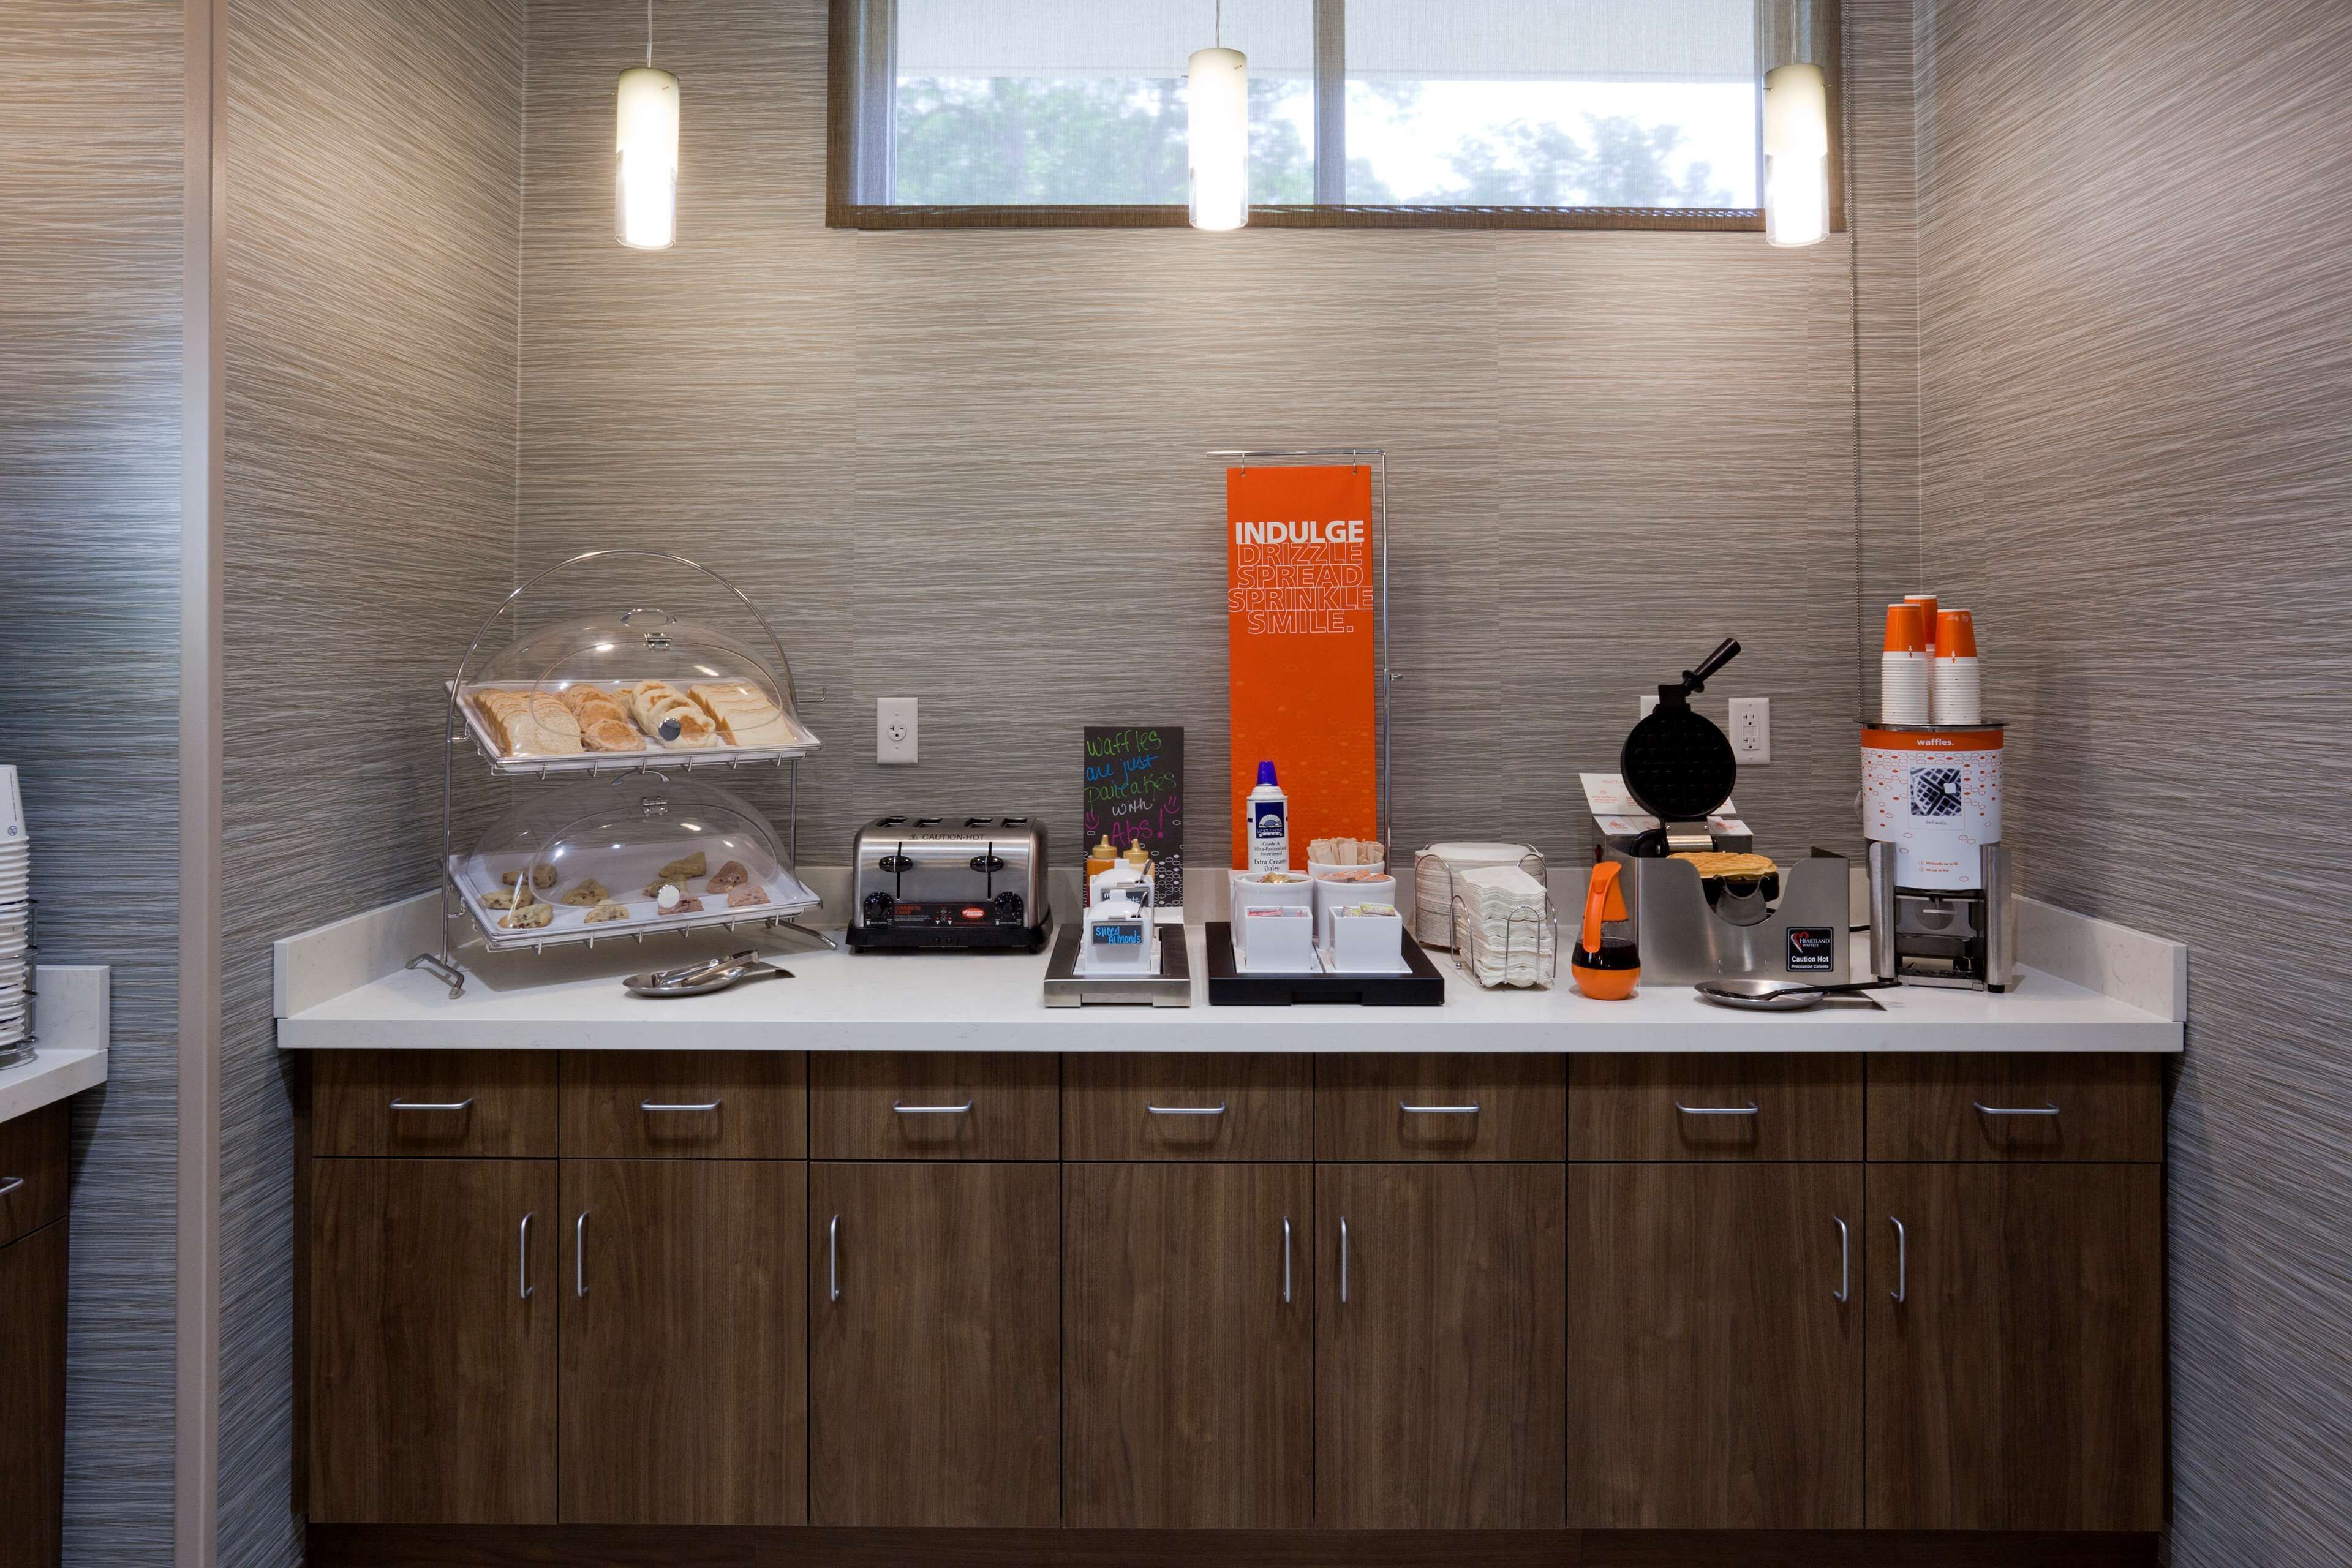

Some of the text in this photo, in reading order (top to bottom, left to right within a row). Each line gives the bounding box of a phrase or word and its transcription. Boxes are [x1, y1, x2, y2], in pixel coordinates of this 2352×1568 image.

[1235, 521, 1365, 544] INDULGE
[1238, 542, 1363, 567] DRIZZLE
[1237, 564, 1363, 589] SPREAD
[1228, 586, 1373, 612] SPRINKLE
[1248, 609, 1354, 634] SMILE.
[1086, 764, 1114, 782] are
[1112, 797, 1153, 816] with
